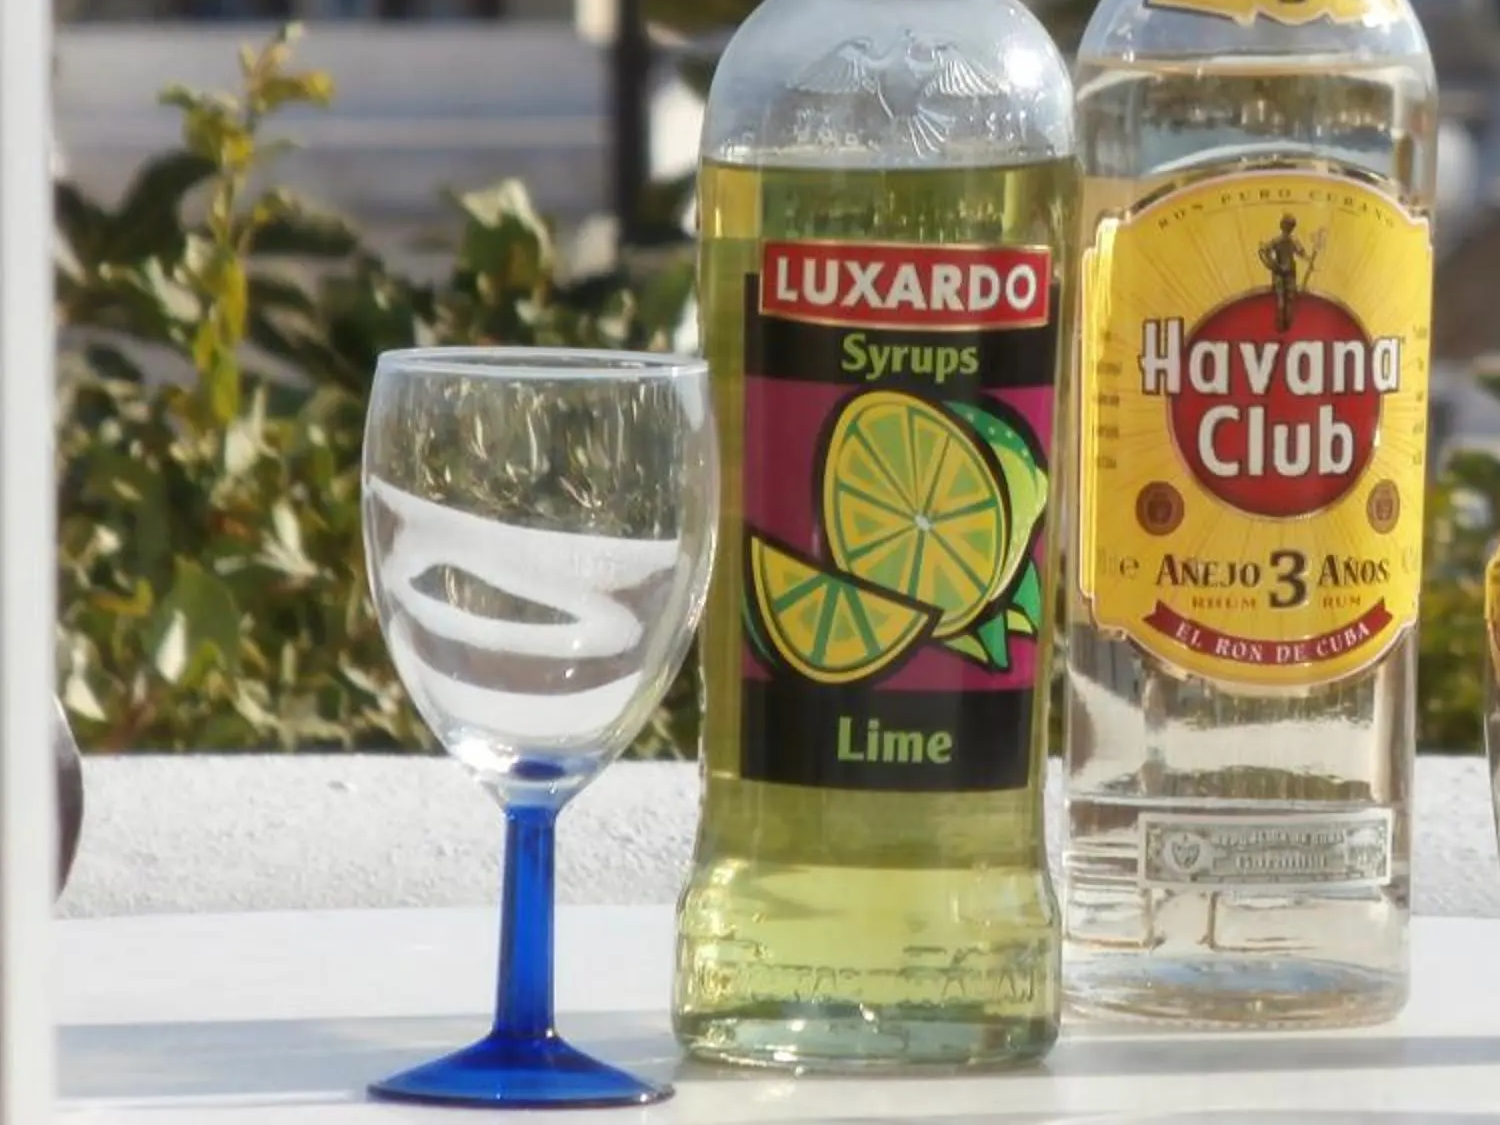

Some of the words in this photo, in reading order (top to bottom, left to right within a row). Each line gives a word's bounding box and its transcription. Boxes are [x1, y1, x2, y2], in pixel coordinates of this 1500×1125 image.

[776, 256, 1037, 312] LUXARDO
[841, 333, 980, 384] Syrups
[1138, 317, 1401, 396] Havana
[1196, 403, 1354, 478] Club
[1156, 553, 1262, 589] AÑEJO
[1268, 549, 1309, 610] 3
[1316, 553, 1391, 589] AÑOS
[1322, 595, 1362, 609] RUM
[1176, 622, 1201, 647] EL
[1215, 636, 1263, 663] RON
[1276, 644, 1307, 664] DE
[1315, 622, 1371, 658] CUBA
[838, 716, 952, 764] Lime
